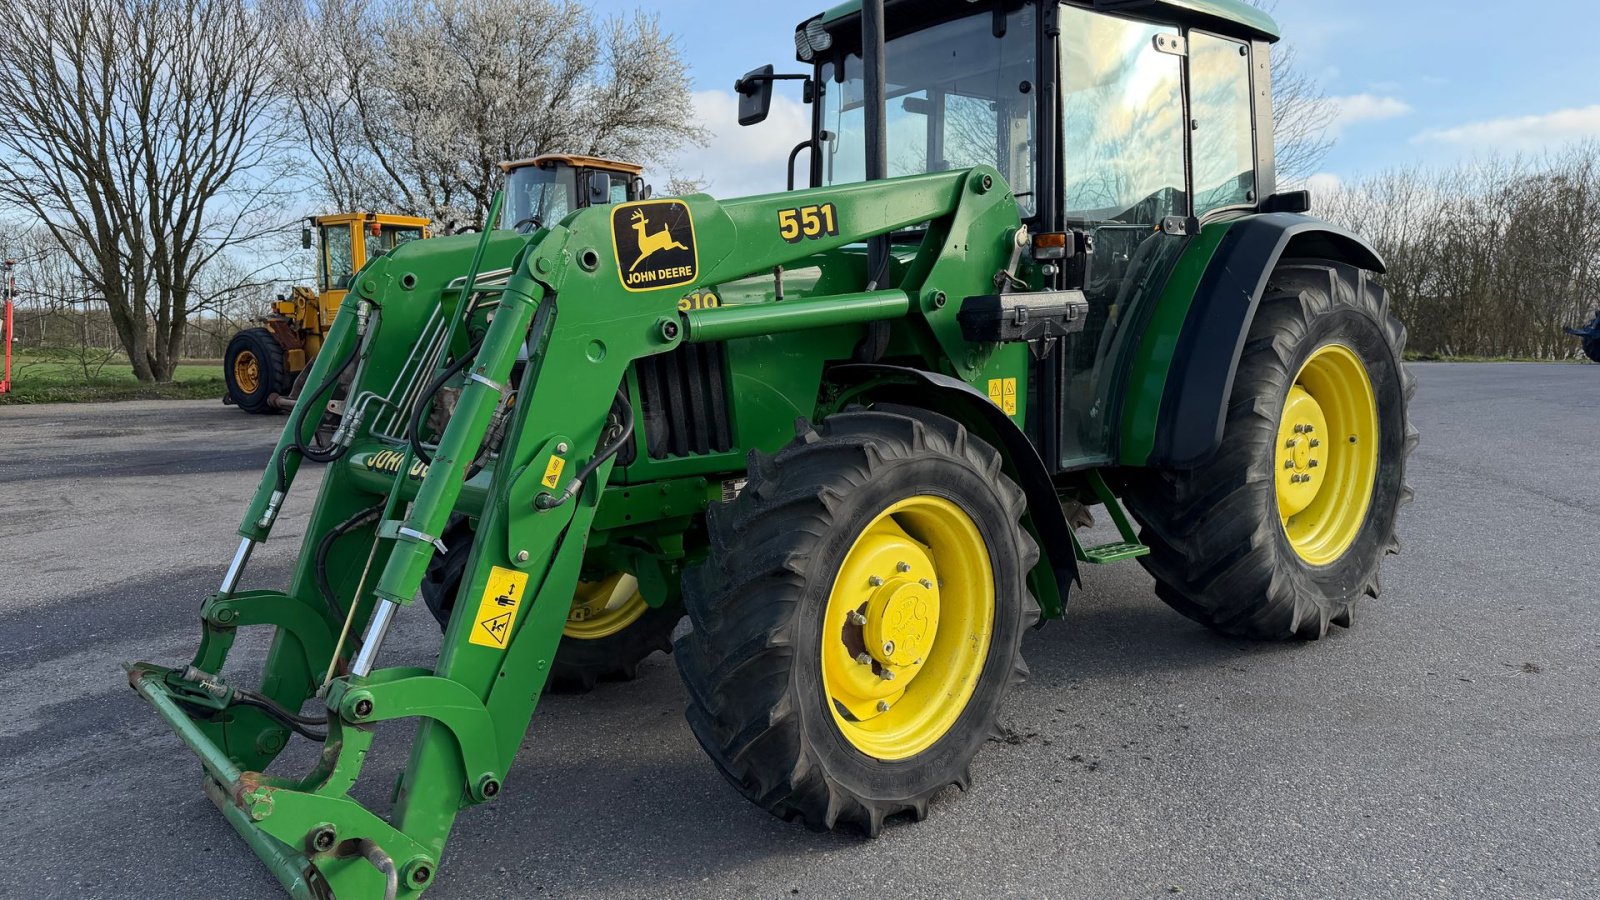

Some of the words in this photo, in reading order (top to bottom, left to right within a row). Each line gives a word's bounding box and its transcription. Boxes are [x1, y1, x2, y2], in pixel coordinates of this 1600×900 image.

[777, 203, 839, 244] 551
[627, 270, 657, 285] JOHN
[658, 265, 693, 280] DEERE
